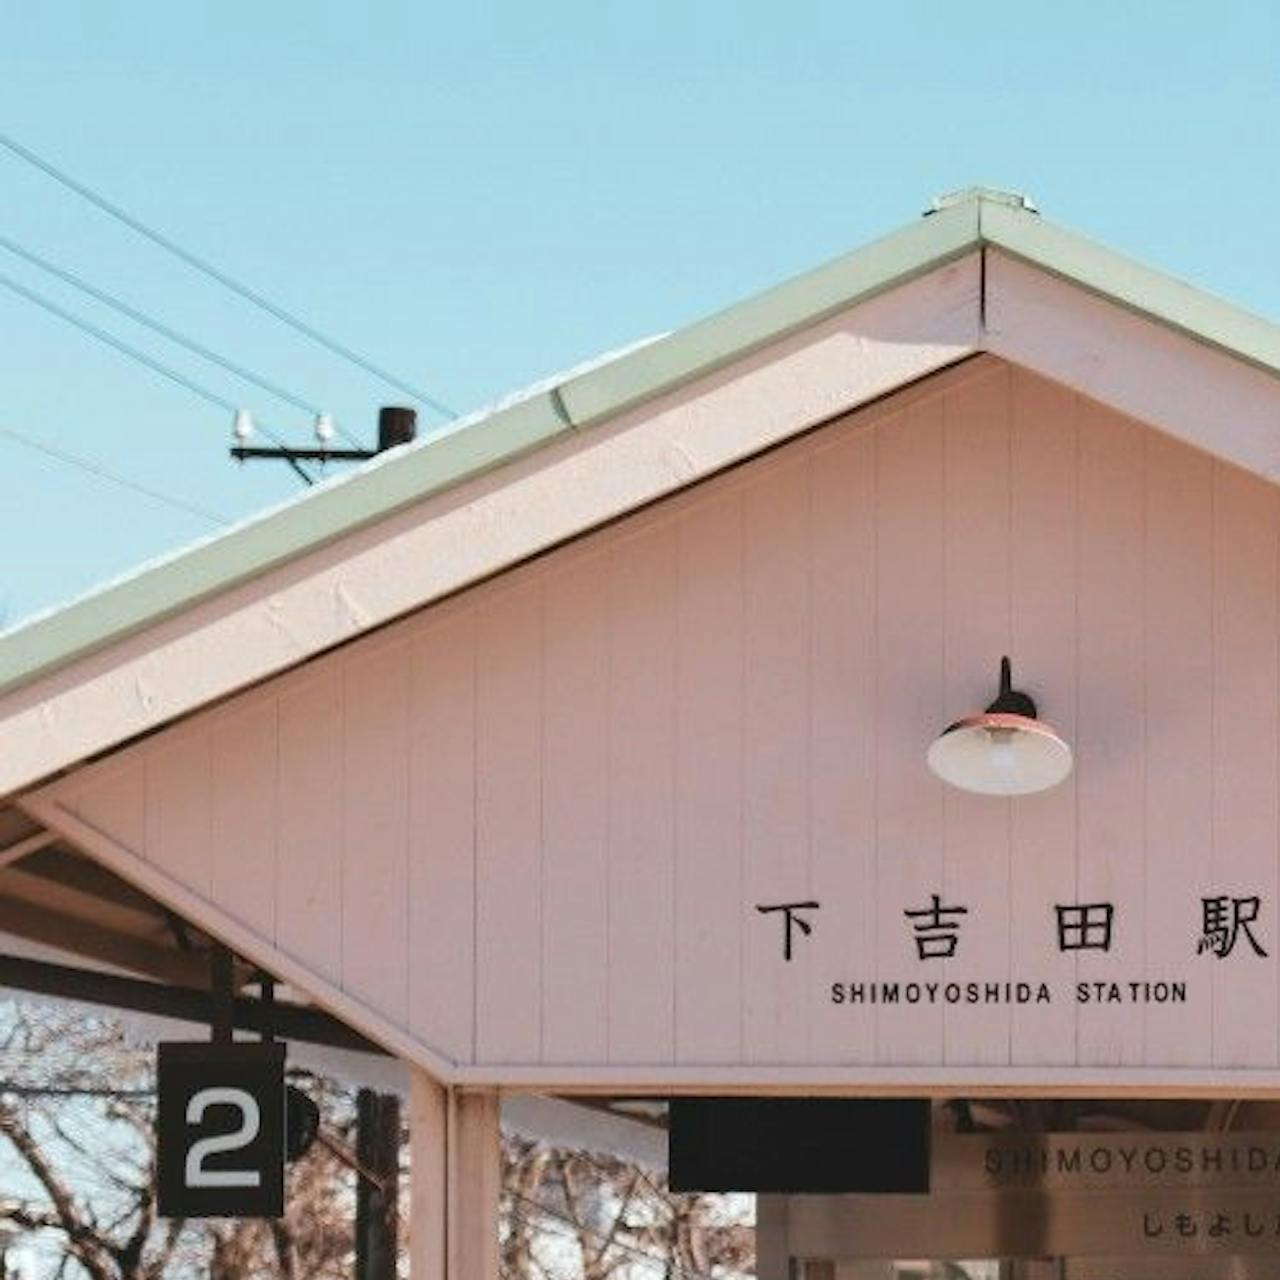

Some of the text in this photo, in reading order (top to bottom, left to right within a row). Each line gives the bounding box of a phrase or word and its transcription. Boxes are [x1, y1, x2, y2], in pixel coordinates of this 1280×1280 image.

[756, 895, 1268, 961] 下吉田駅
[831, 982, 1187, 1004] SHIMOYOSHIDA STATION
[185, 1087, 261, 1187] 2
